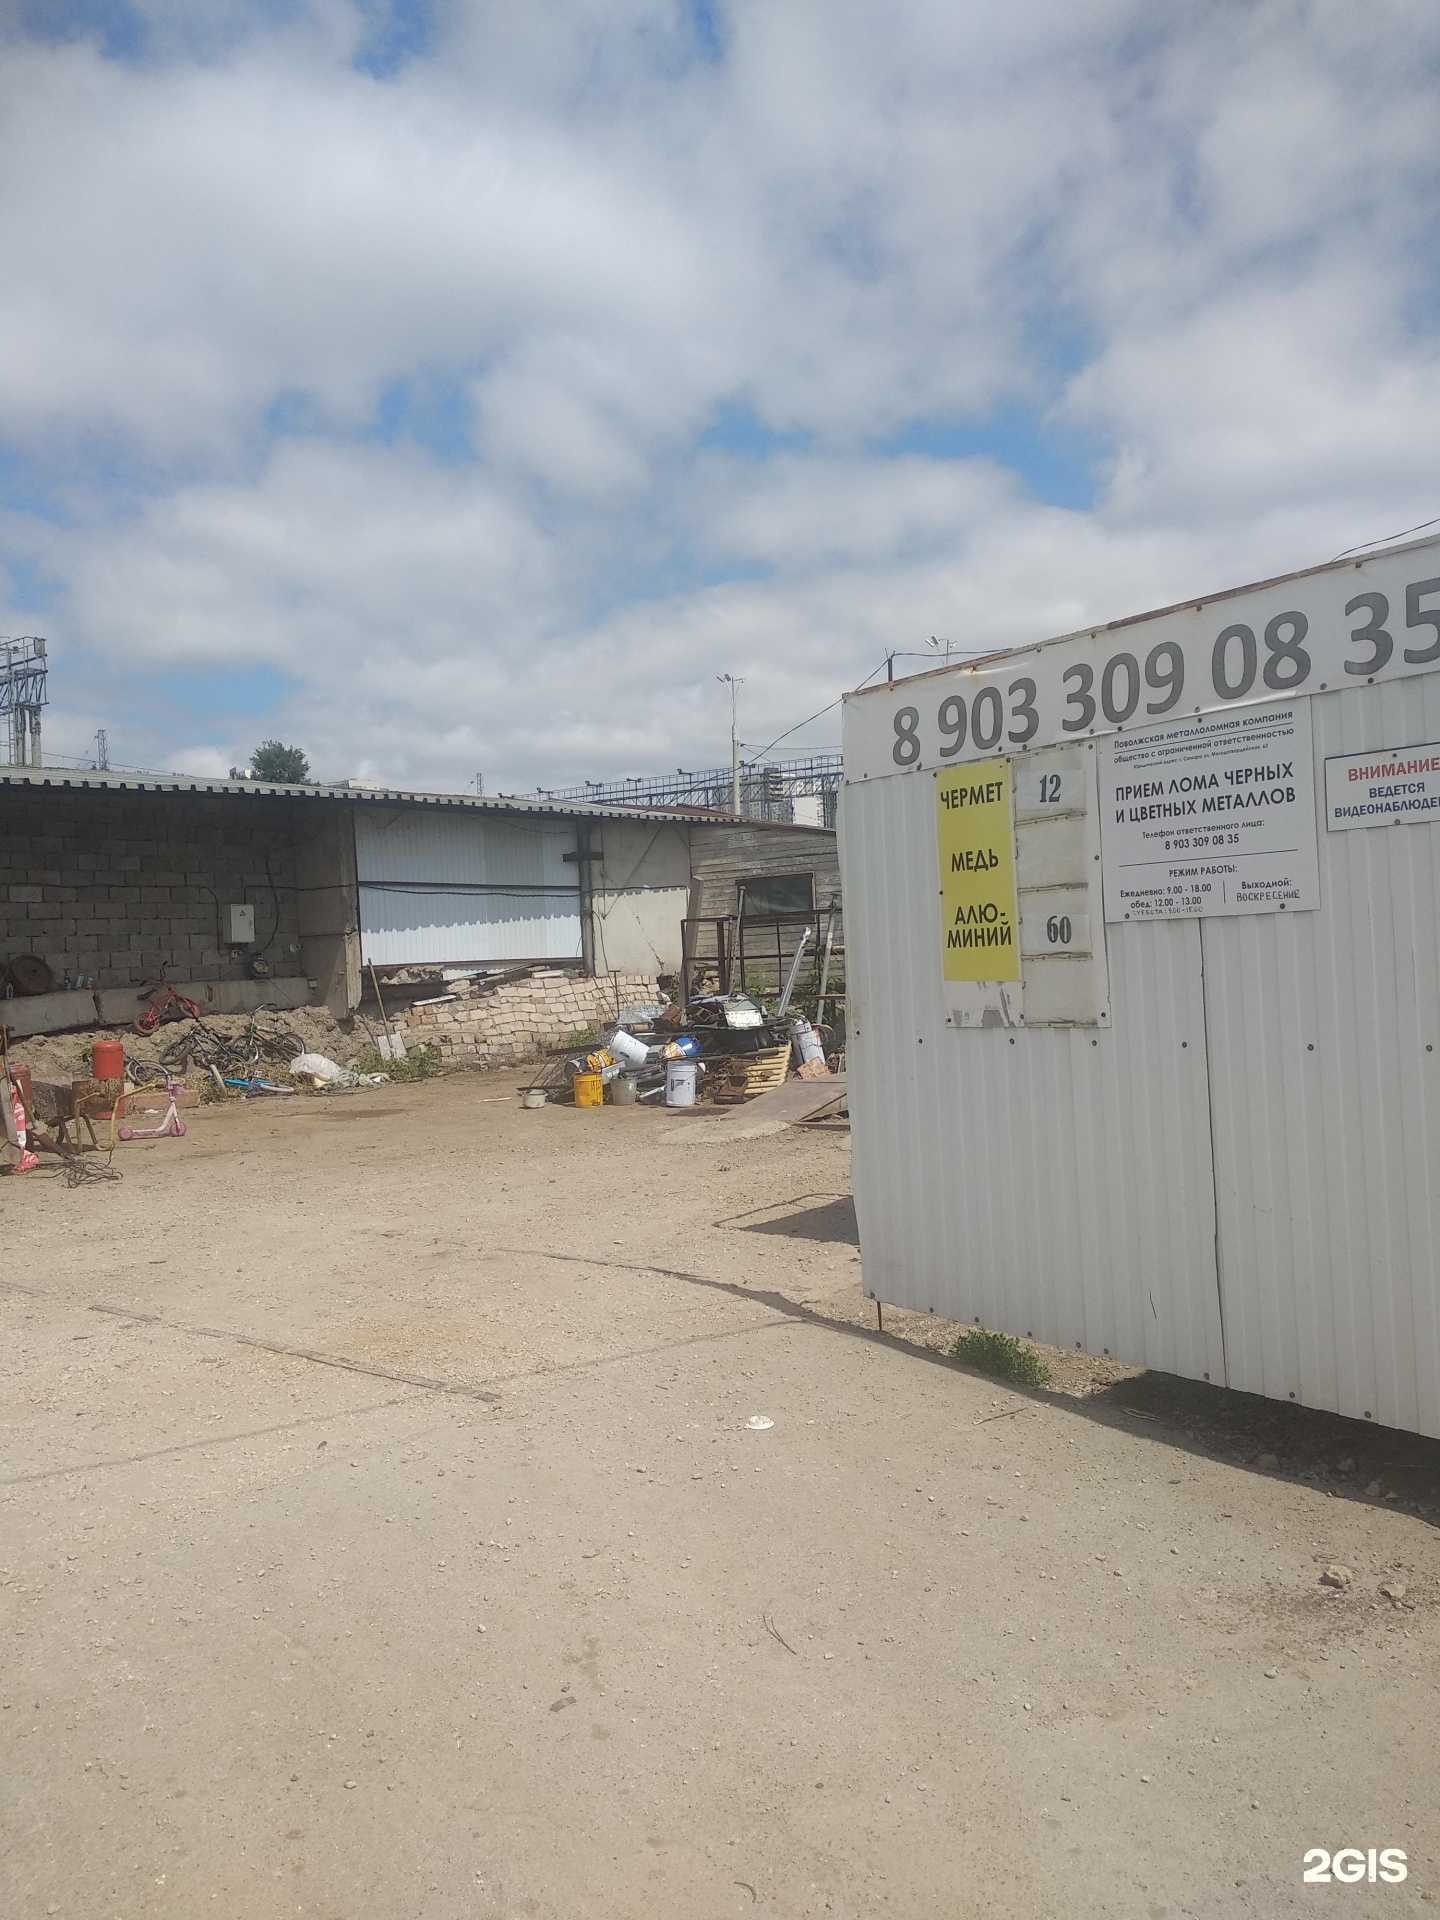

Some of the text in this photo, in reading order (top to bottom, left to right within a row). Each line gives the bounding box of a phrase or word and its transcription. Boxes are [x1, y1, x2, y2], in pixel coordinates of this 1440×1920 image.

[892, 577, 1440, 767] 8 903 309 08 35
[1114, 711, 1293, 749] Поволжская металлоломная компания
[1113, 751, 1150, 764] общество
[1158, 740, 1212, 757] ограниченной
[1213, 727, 1295, 747] ответственностью
[1039, 774, 1062, 803] 12
[1115, 762, 1294, 801] ПРИЕМ ЛОМА ЧЕРНЫХ
[1369, 782, 1425, 799] ВЕДЕТСЯ
[940, 782, 1003, 810] ЧЕРМЕТ
[1115, 787, 1296, 823] И ЦВЕТНЫХ МЕТАЛЛОВ
[1334, 797, 1440, 818] ВИДЕОНАБЛЮДЕ
[1142, 819, 1265, 840] Телефон ответственного лица:
[1165, 833, 1240, 850] 8 903 309 08 35
[951, 848, 999, 872] МЕДЬ
[1168, 864, 1240, 878] РЕЖИМ РАБОТЫ:
[1120, 888, 1166, 898] Ежедневно:
[1167, 885, 1183, 895] 9.00
[1190, 883, 1212, 893] 18.00
[1236, 889, 1301, 902] ВОСКРЕСЕНИЕ
[1241, 878, 1293, 890] Выходной:
[1154, 897, 1174, 907] 12.00
[1181, 896, 1202, 906] 13.00
[954, 903, 1006, 925] АЛЮ-
[947, 920, 1012, 949] МИНИЙ
[1046, 915, 1072, 944] 60
